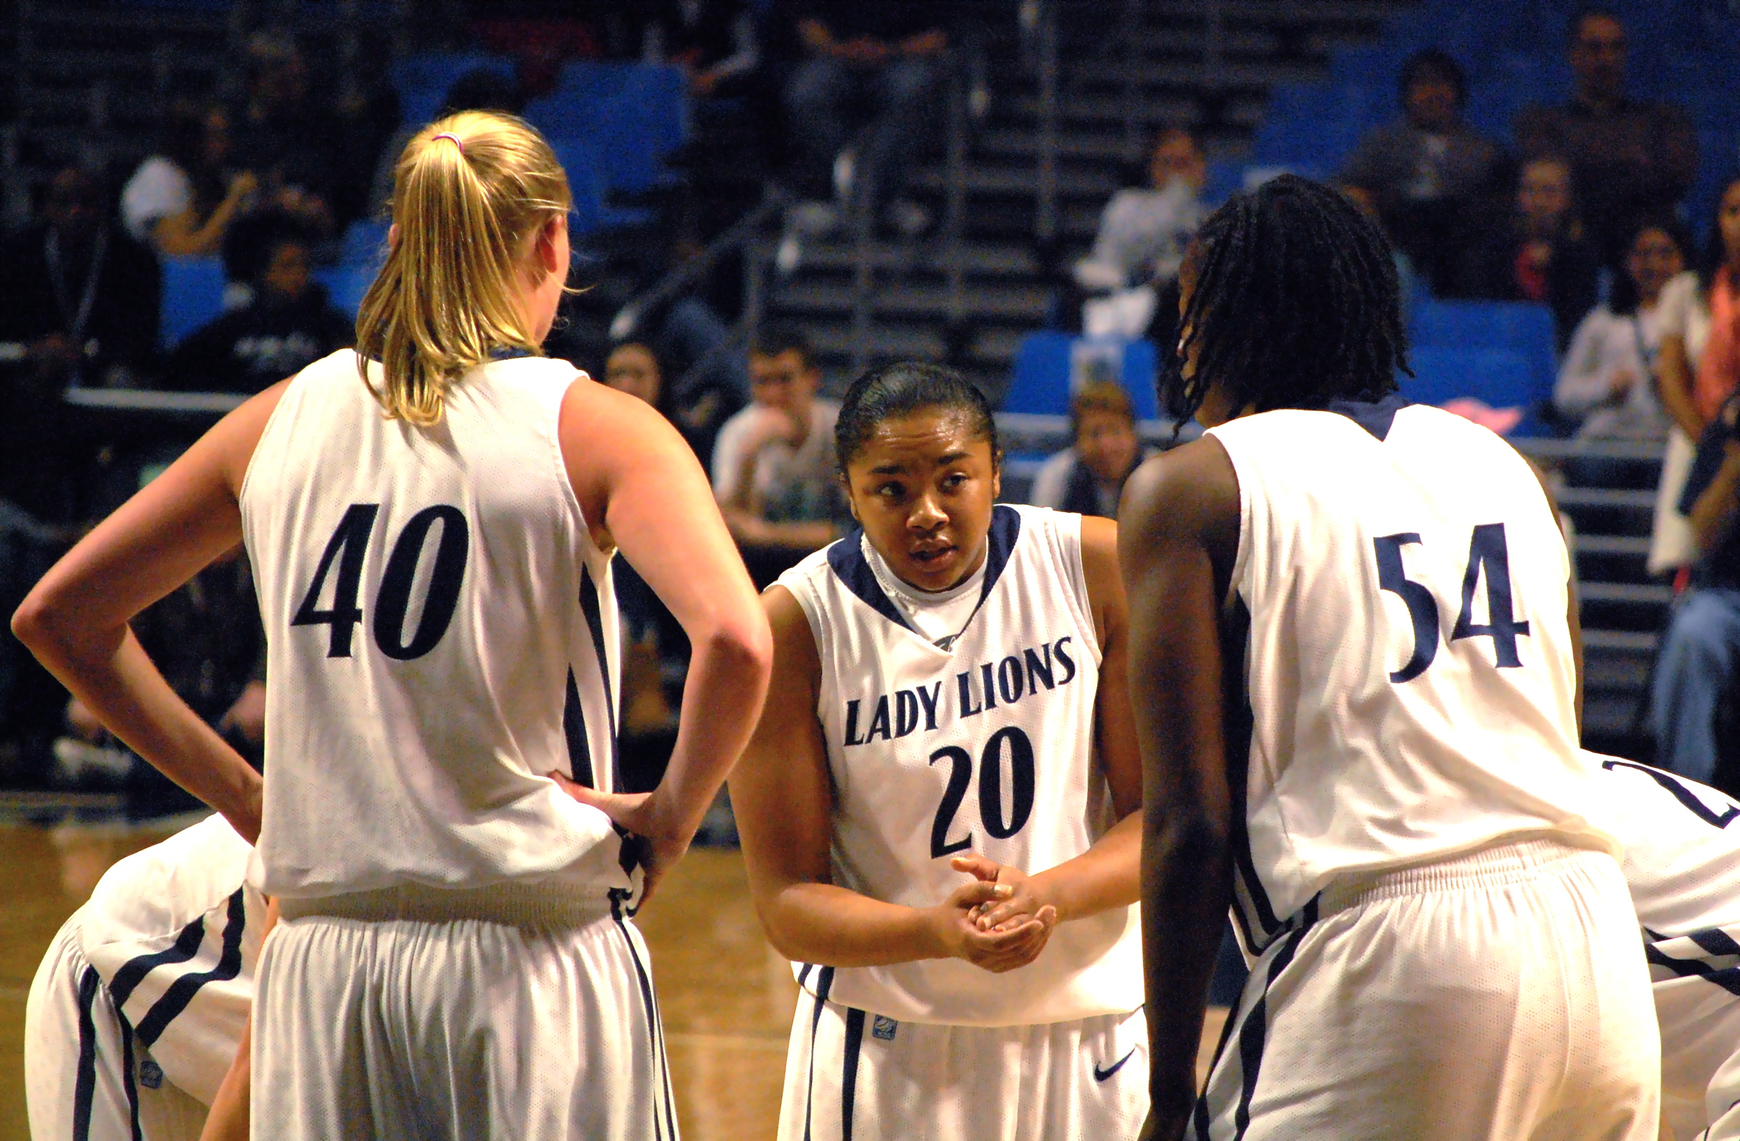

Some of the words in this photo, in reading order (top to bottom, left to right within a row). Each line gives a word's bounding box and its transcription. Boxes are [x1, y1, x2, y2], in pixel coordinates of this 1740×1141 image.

[290, 503, 470, 661] 40
[1373, 522, 1531, 684] 54
[843, 681, 942, 747] LADY
[957, 636, 1076, 719] LIONS
[929, 726, 1035, 860] 20
